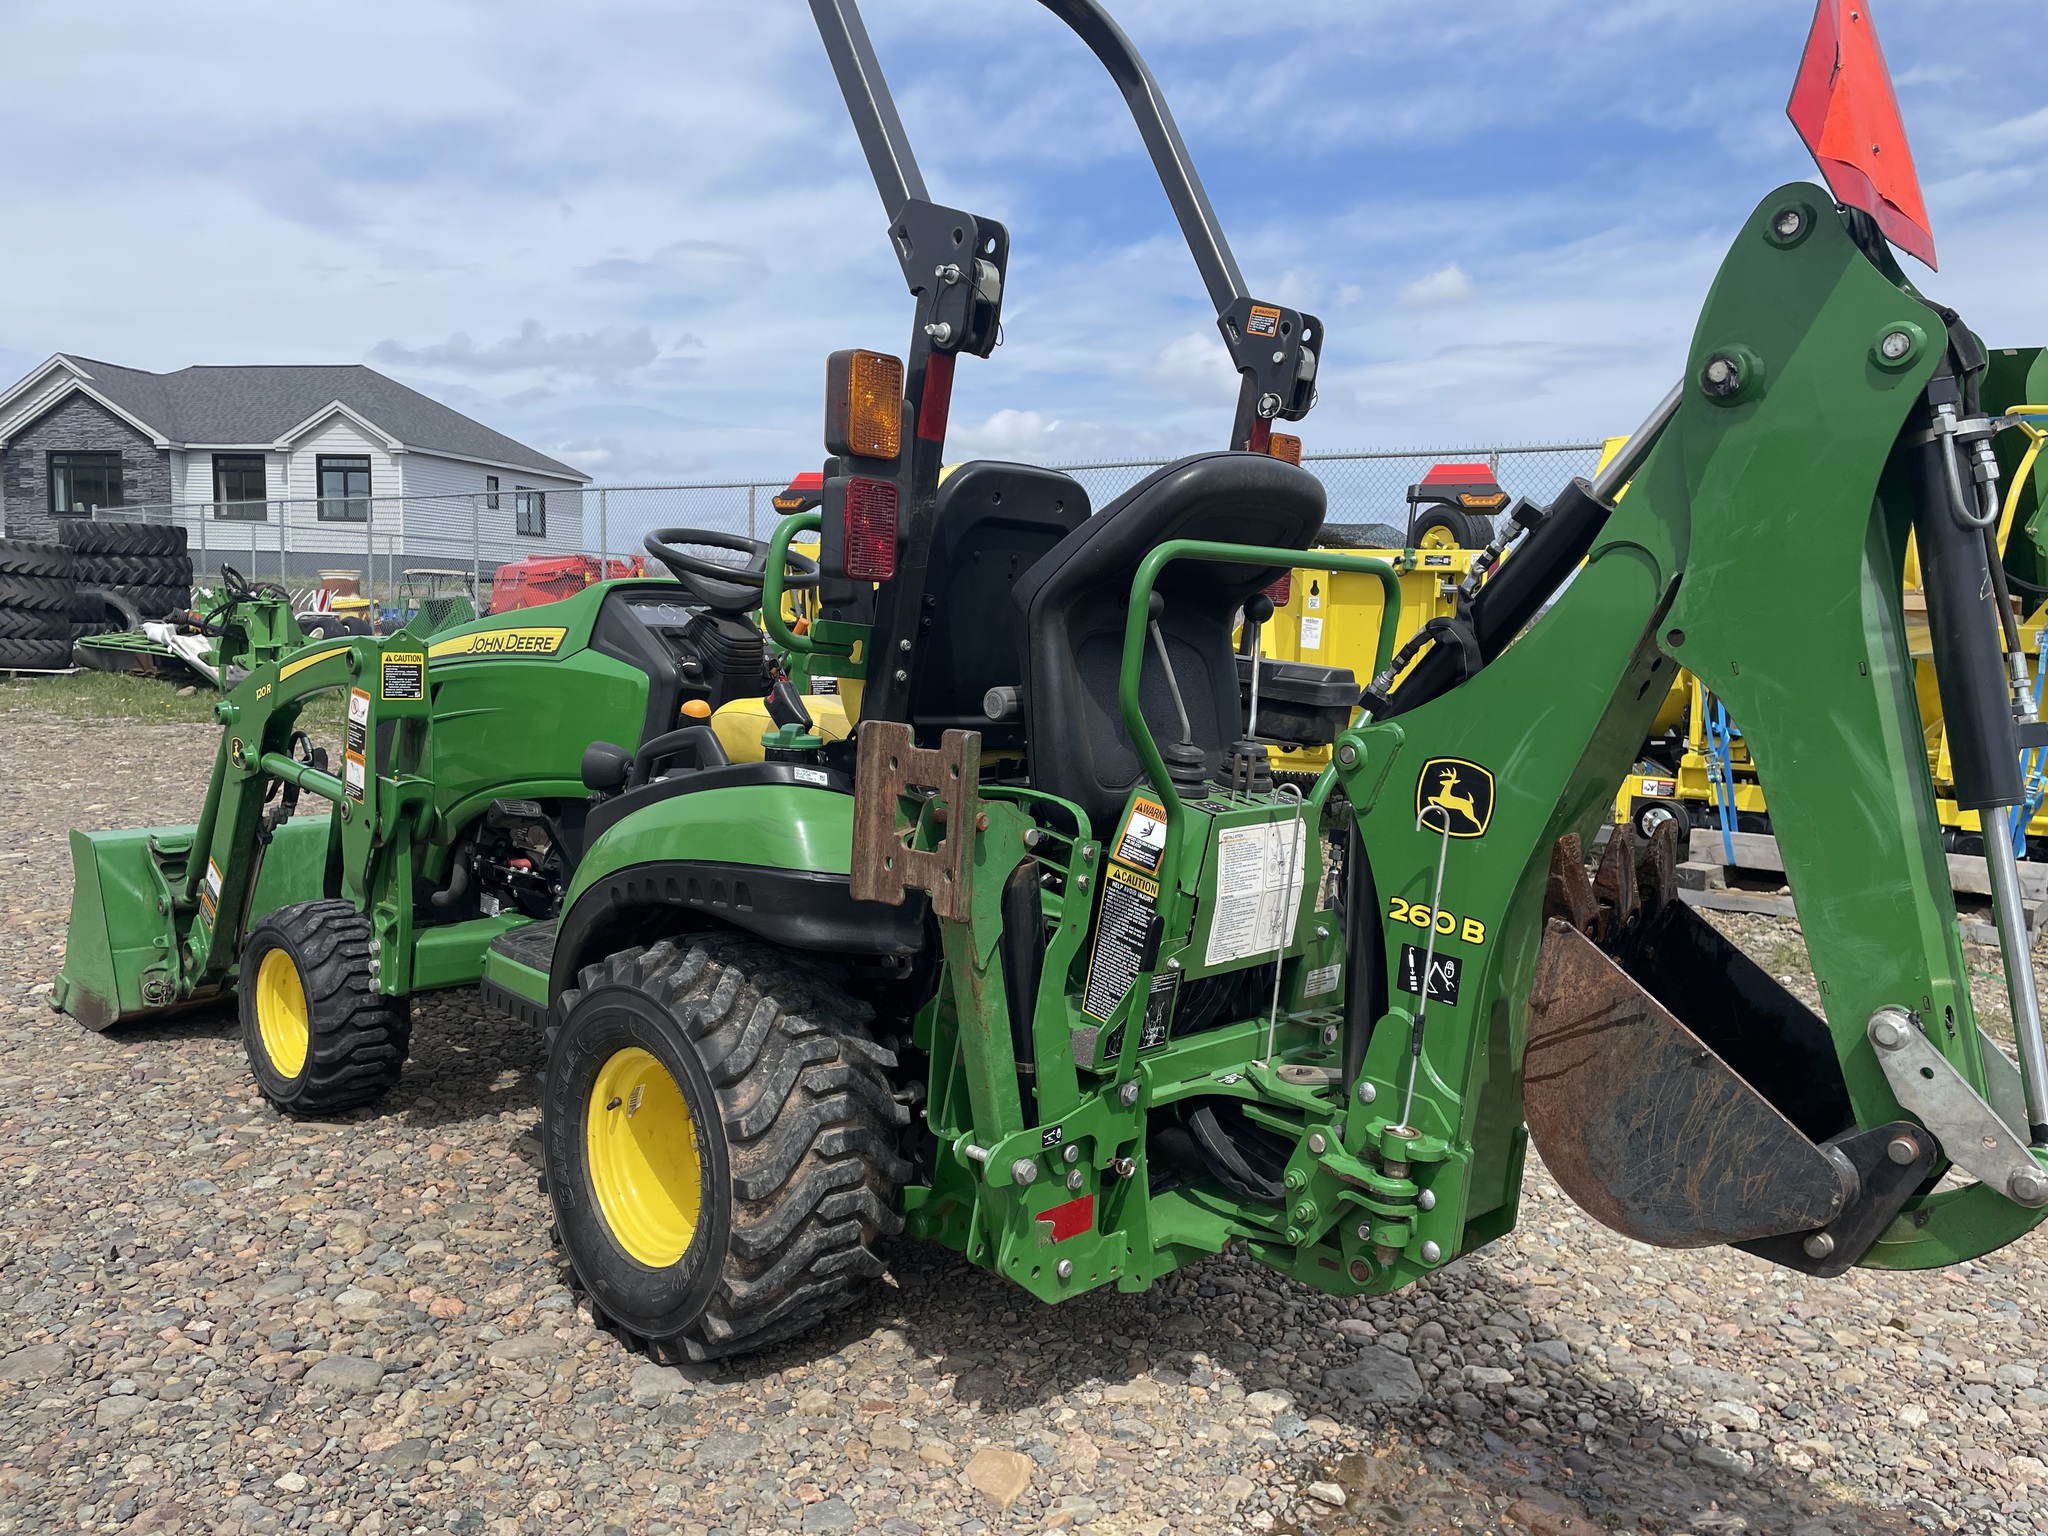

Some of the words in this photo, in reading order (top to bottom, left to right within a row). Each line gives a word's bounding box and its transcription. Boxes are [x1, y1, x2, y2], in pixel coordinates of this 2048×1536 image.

[467, 635, 504, 652] JOHN
[505, 633, 554, 650] DEERE
[393, 654, 422, 663] CAUTION
[1143, 803, 1167, 822] WARNI
[1111, 881, 1124, 890] HELP
[1123, 886, 1138, 896] AVOID
[1137, 891, 1154, 903] INJURY
[1121, 871, 1157, 895] CAUTION
[1388, 896, 1458, 935] 260
[1461, 917, 1486, 945] B
[551, 1039, 582, 1210] CARLISLE
